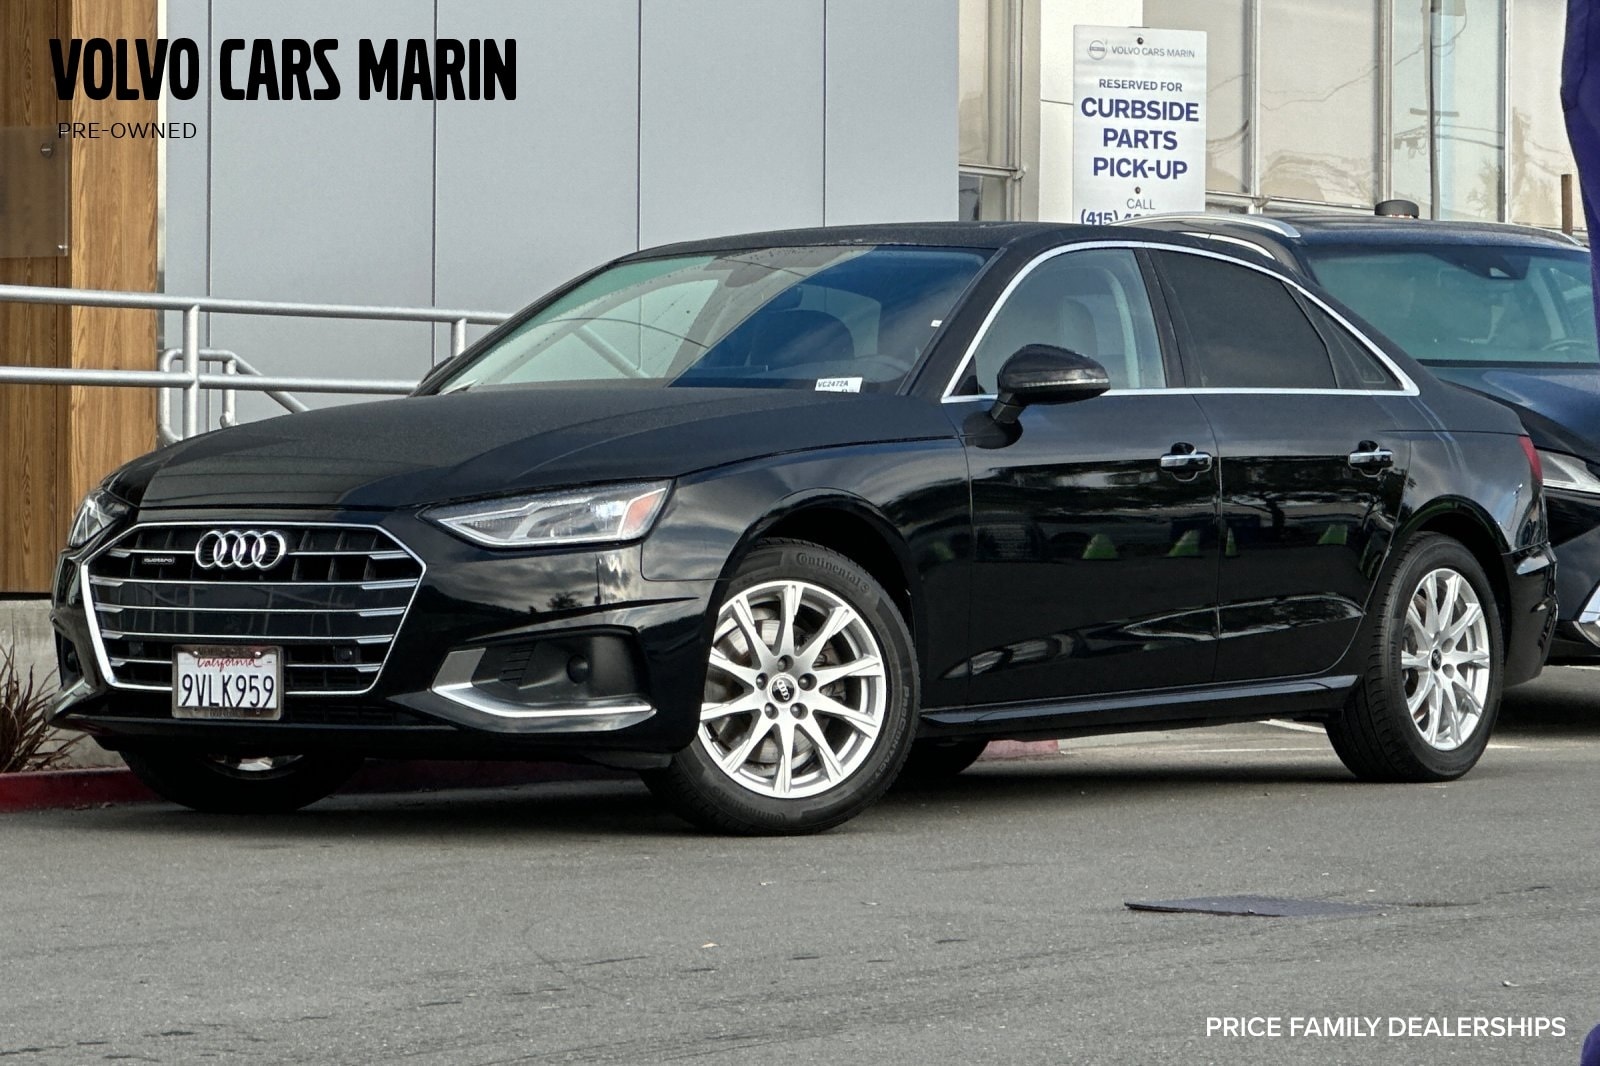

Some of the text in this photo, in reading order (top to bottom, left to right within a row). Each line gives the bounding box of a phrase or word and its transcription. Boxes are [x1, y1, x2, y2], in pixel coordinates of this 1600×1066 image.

[1111, 45, 1196, 59] VOLVO CARS MARIN
[1098, 78, 1183, 92] RESERVED FOR
[1081, 97, 1199, 122] CURBSIDE
[1103, 127, 1178, 151] PARTS
[1093, 156, 1188, 180] PICK-UP
[1126, 198, 1156, 210] CALL
[796, 552, 861, 587] Continental
[181, 673, 275, 709] 9VLK959
